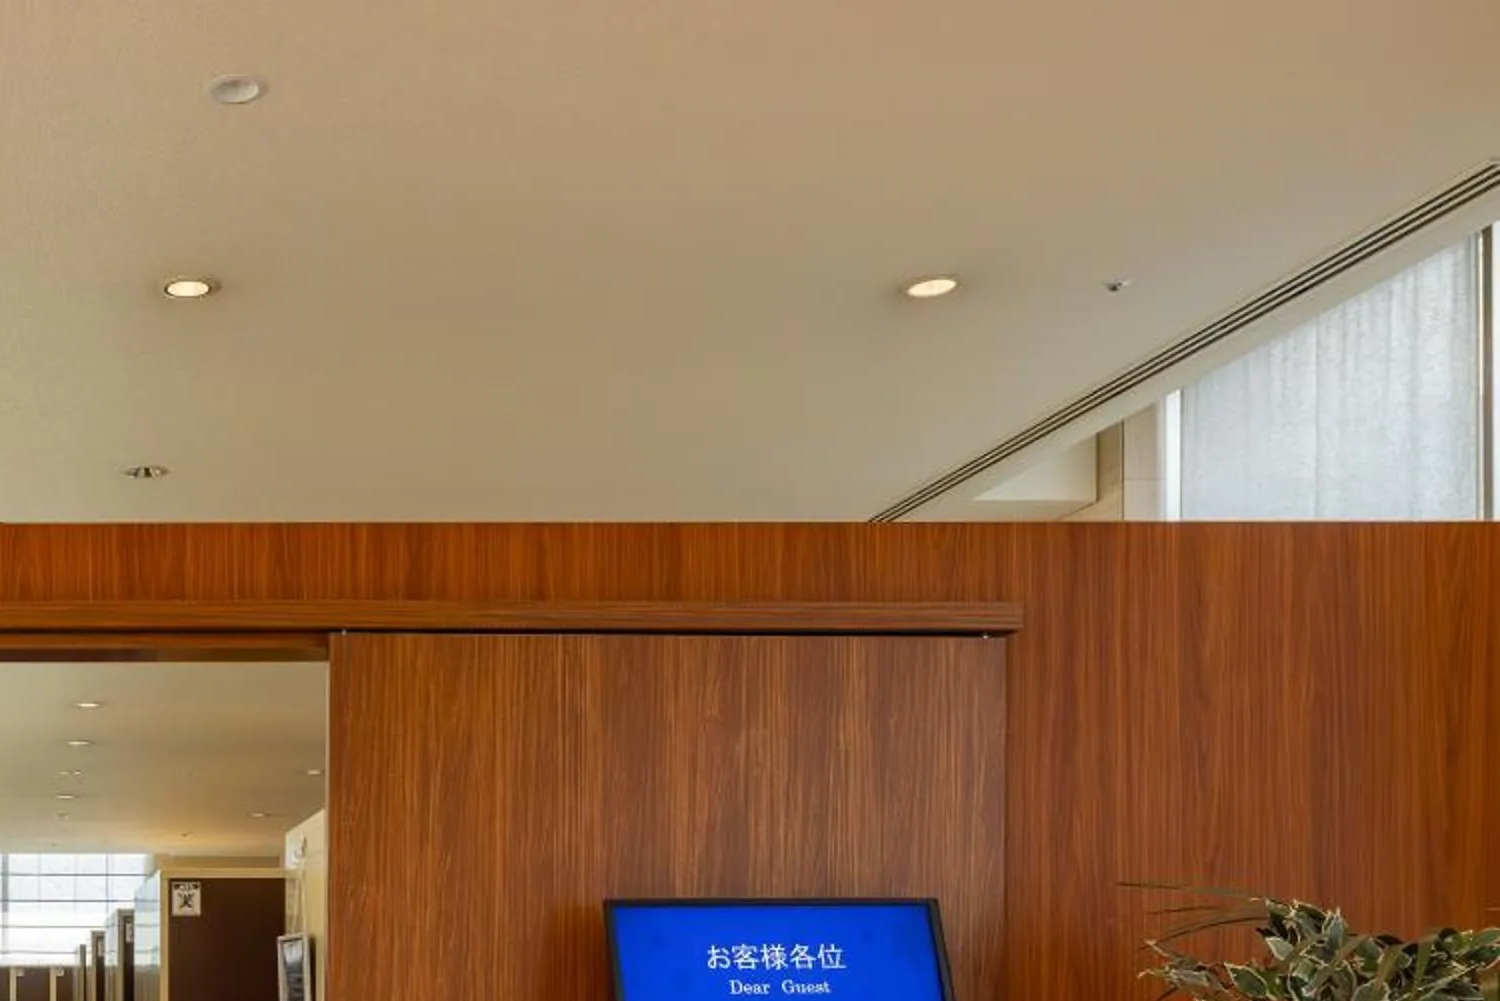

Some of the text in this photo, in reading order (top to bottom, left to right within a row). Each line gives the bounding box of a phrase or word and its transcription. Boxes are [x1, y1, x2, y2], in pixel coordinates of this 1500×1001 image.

[707, 943, 847, 970] お客様各位
[729, 979, 832, 995] Dear Guest
